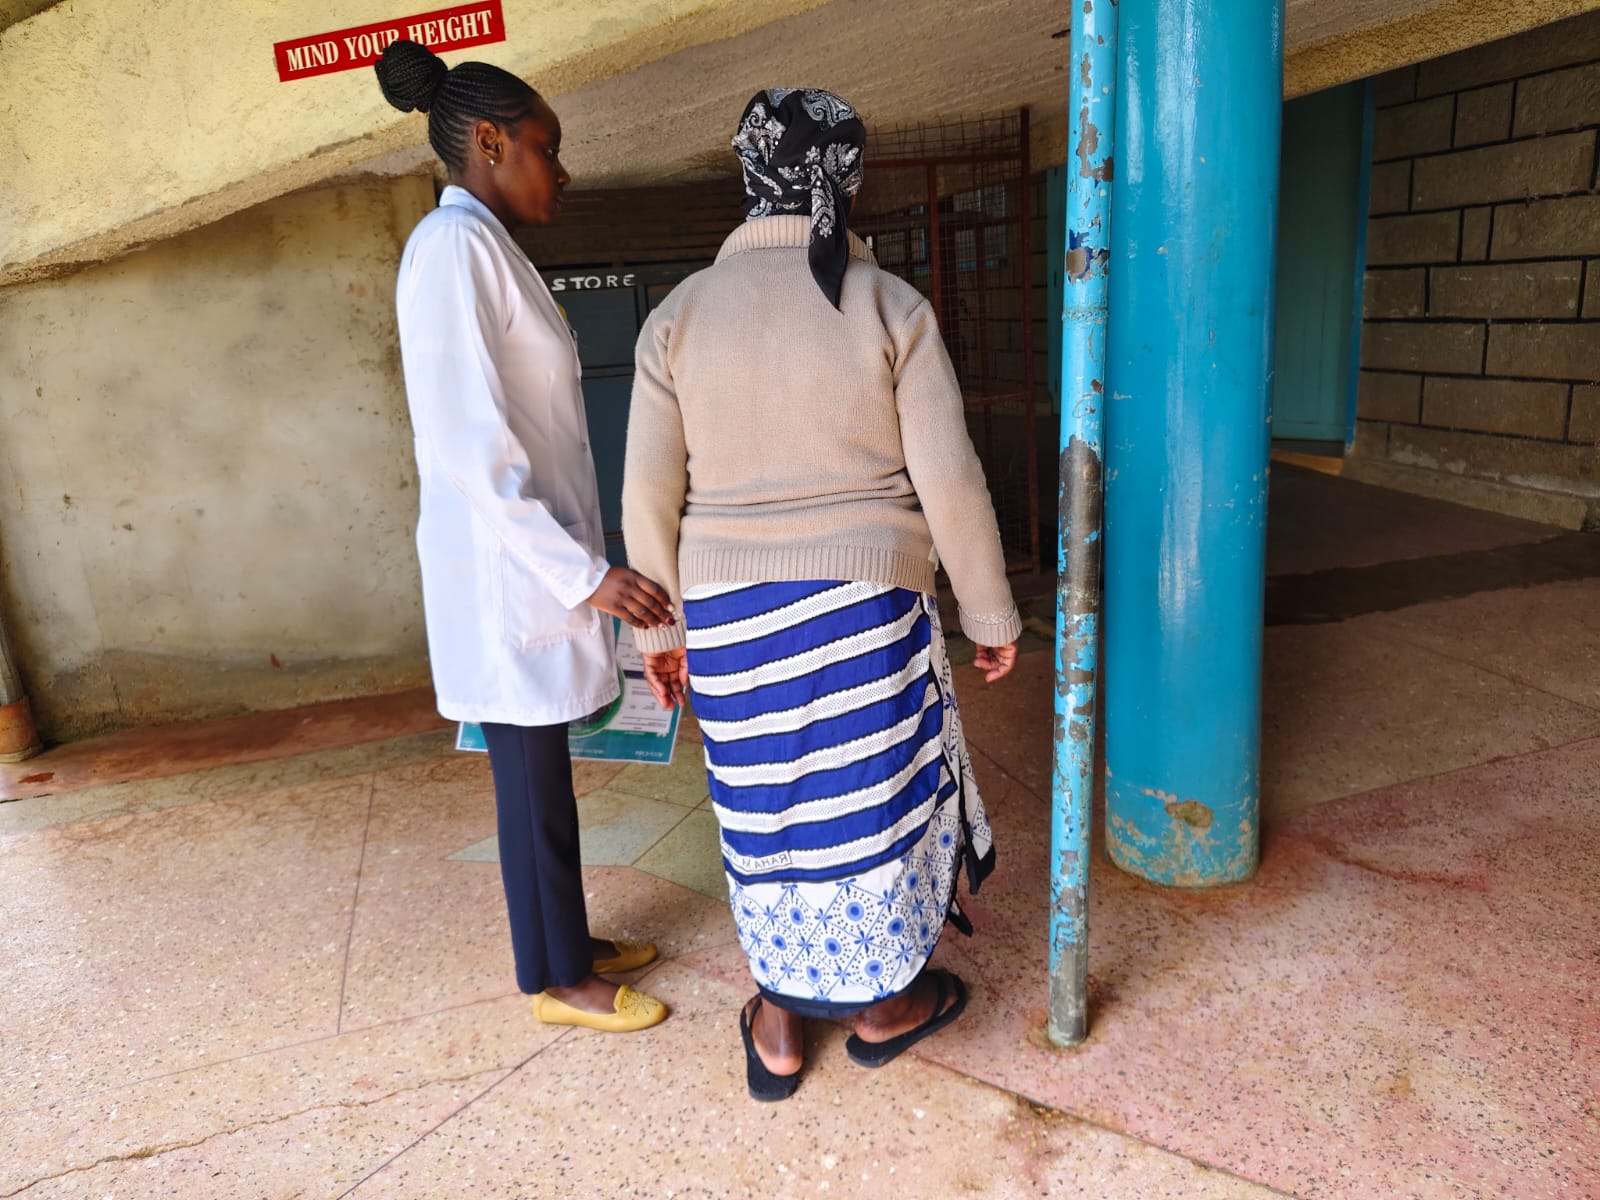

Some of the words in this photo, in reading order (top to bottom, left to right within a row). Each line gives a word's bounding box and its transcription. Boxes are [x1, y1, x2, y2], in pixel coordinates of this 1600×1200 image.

[286, 40, 339, 72] MIND
[407, 9, 493, 46] HEIGHT
[551, 273, 635, 292] STORE
